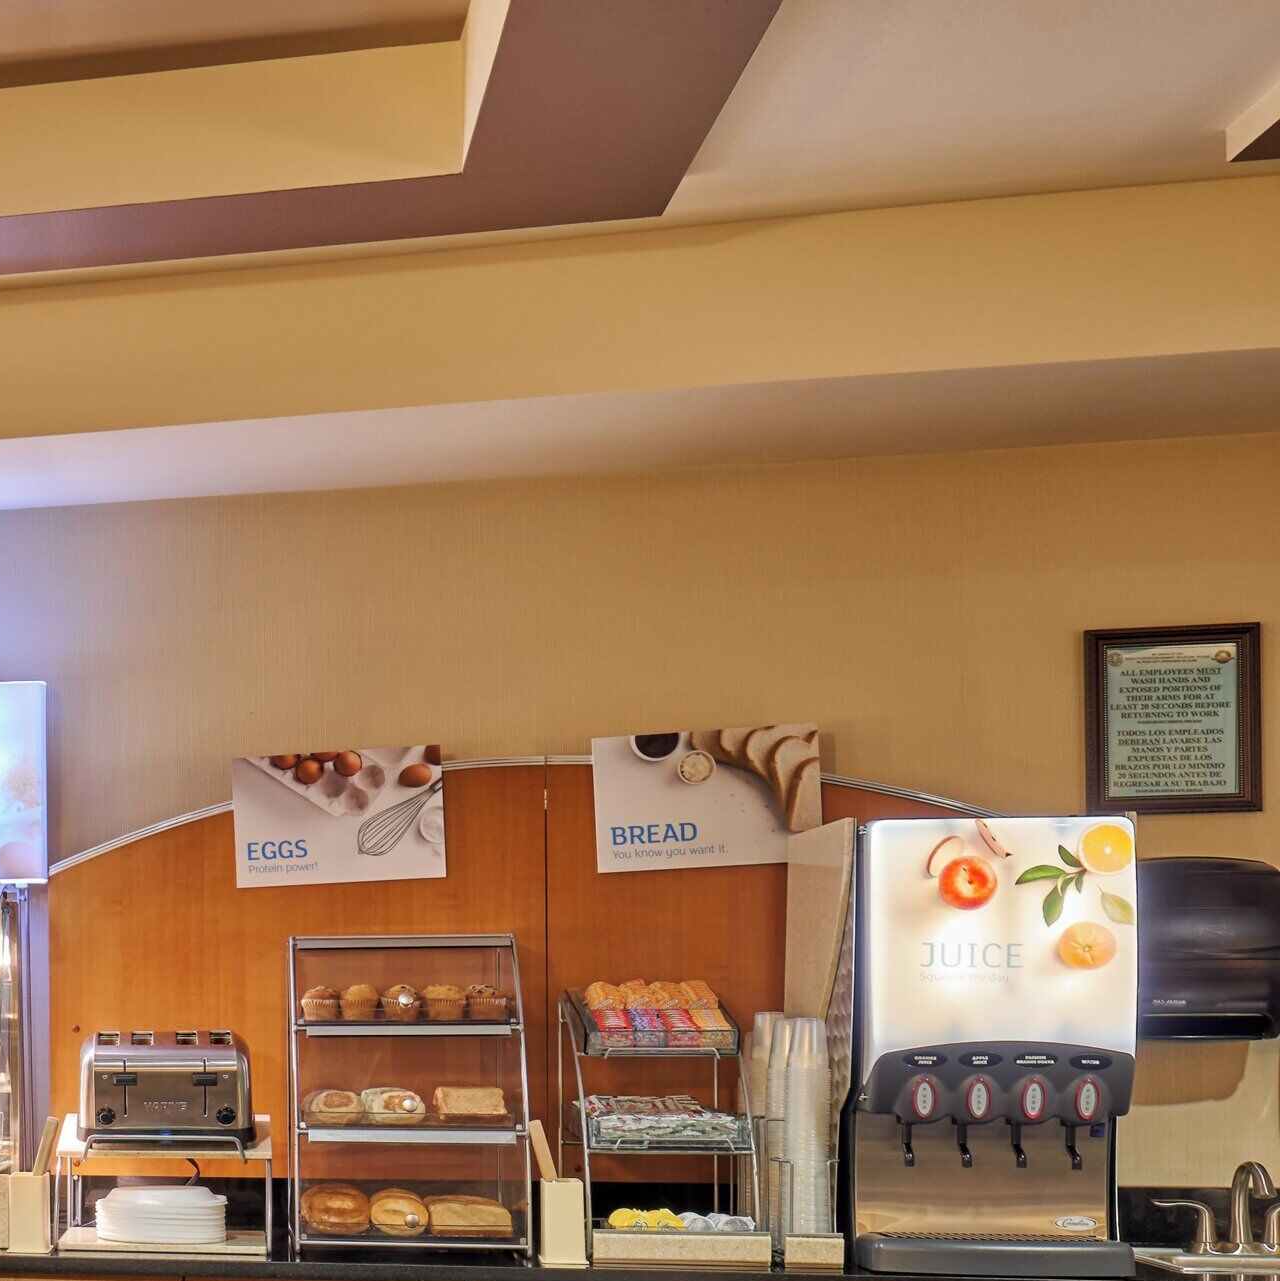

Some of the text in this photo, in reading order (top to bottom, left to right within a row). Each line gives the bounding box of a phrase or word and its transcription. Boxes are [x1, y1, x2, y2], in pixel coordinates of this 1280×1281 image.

[611, 823, 697, 845] BREAD
[248, 839, 308, 860] EGGS
[613, 844, 728, 859] You know you want it.
[248, 862, 318, 873] Protein power!
[920, 943, 1024, 968] JUICE
